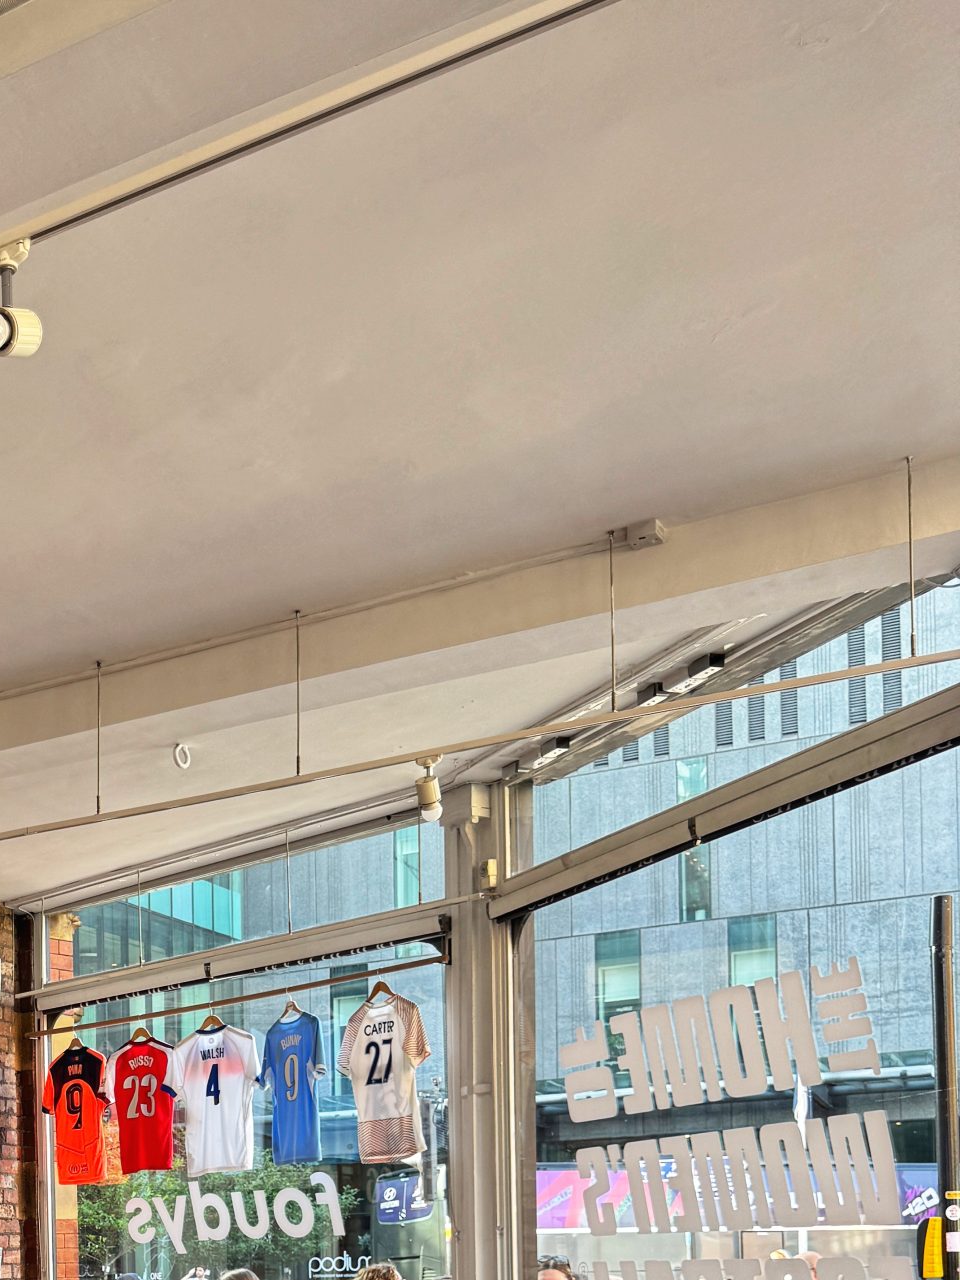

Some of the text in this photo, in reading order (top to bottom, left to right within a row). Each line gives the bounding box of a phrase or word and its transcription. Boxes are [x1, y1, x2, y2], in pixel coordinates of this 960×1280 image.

[364, 1021, 394, 1036] CARTER
[200, 1047, 224, 1061] WALSH
[365, 1038, 392, 1086] 27
[123, 1074, 158, 1118] 23
[206, 1064, 220, 1106] 4
[284, 1054, 299, 1101] 9
[66, 1083, 83, 1129] 9
